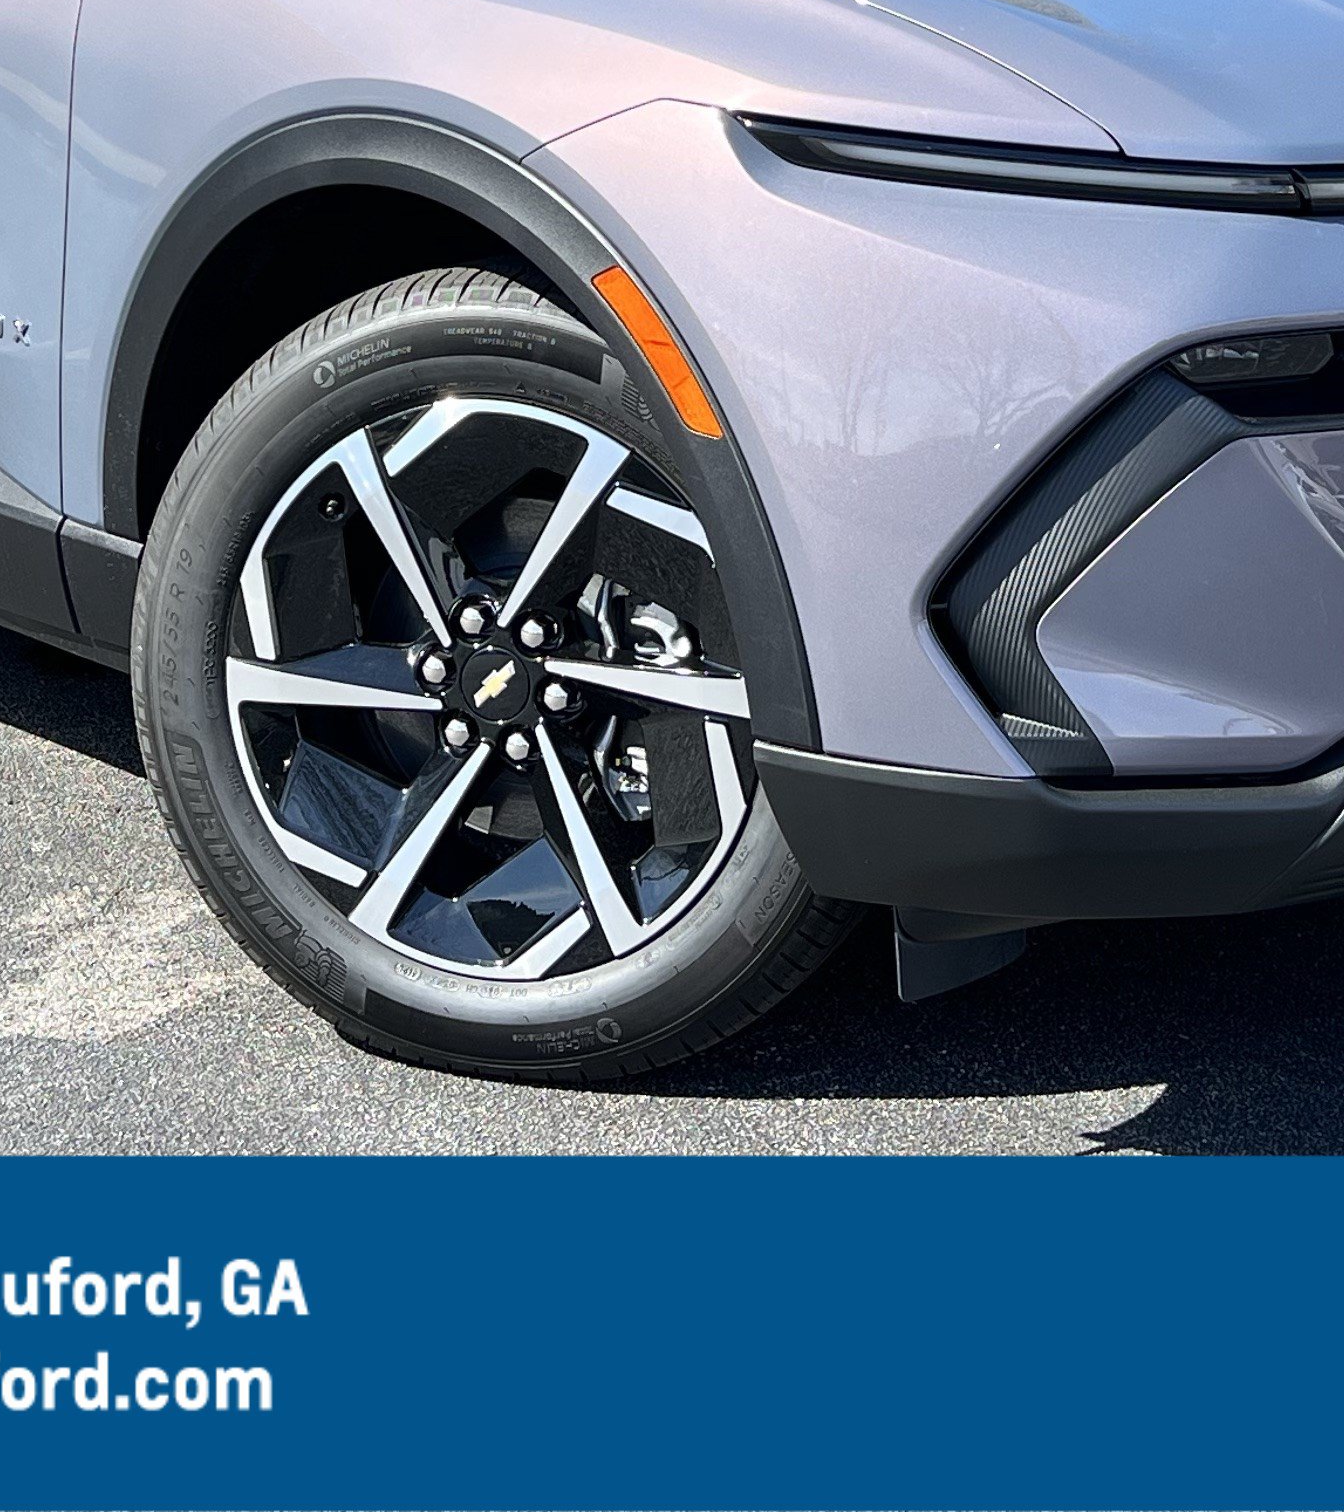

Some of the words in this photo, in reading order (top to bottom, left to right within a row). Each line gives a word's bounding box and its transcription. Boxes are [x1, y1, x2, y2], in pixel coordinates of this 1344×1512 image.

[337, 338, 390, 366] MICHELIN
[357, 345, 412, 369] Performance
[176, 548, 193, 575] 19
[169, 583, 185, 603] R
[171, 742, 293, 940] MICHELIN
[754, 852, 798, 923] SEASON
